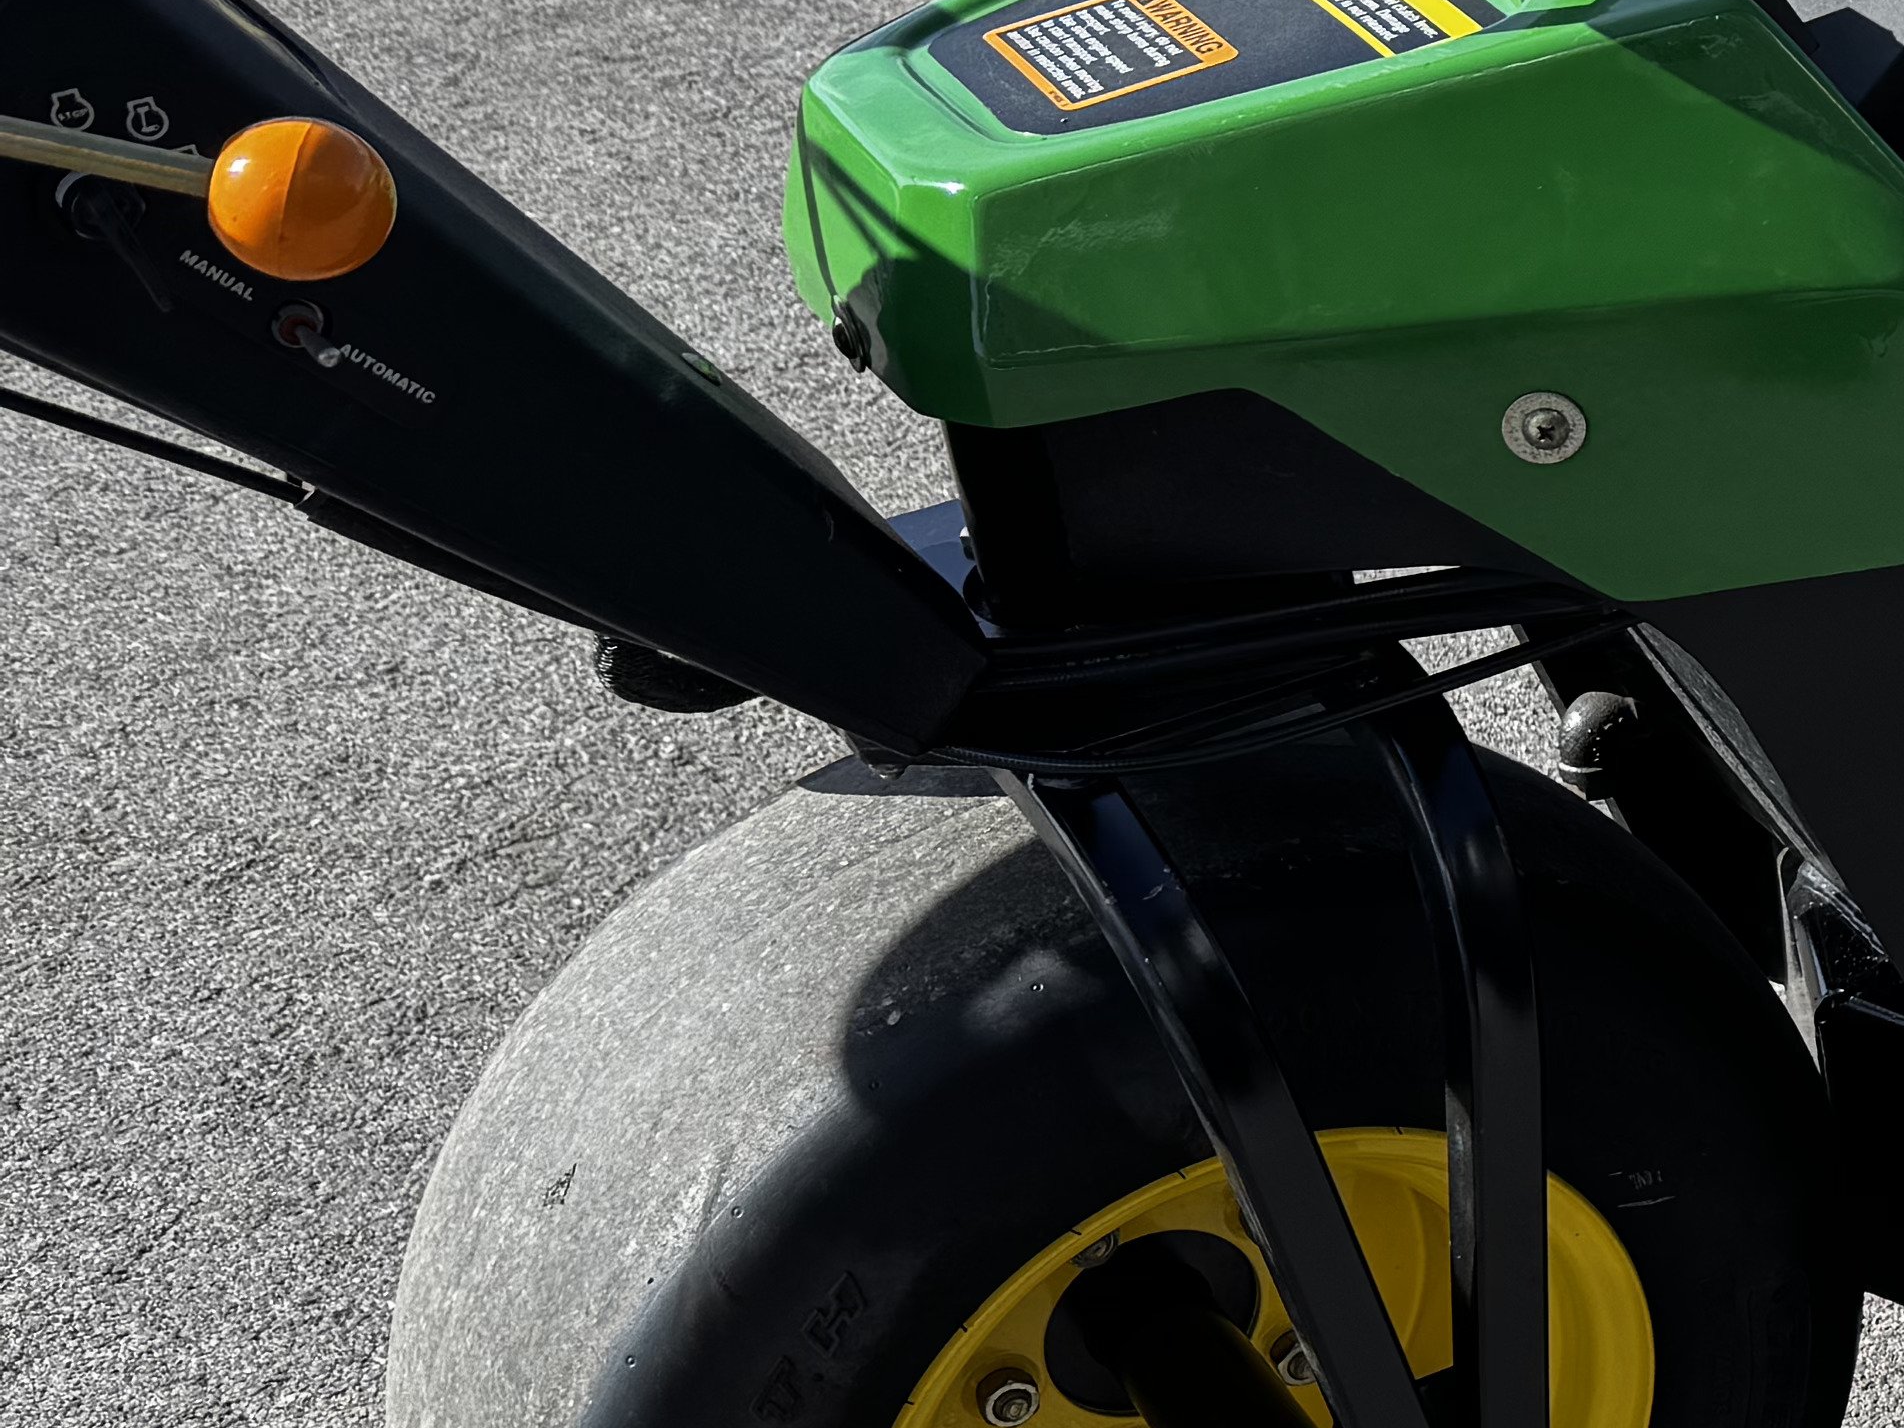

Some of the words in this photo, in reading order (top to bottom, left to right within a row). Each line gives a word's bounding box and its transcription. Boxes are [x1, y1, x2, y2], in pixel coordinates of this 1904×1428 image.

[1146, 0, 1225, 55] WARNING
[179, 249, 254, 302] MANUAL
[338, 343, 437, 404] AUTOMATIC
